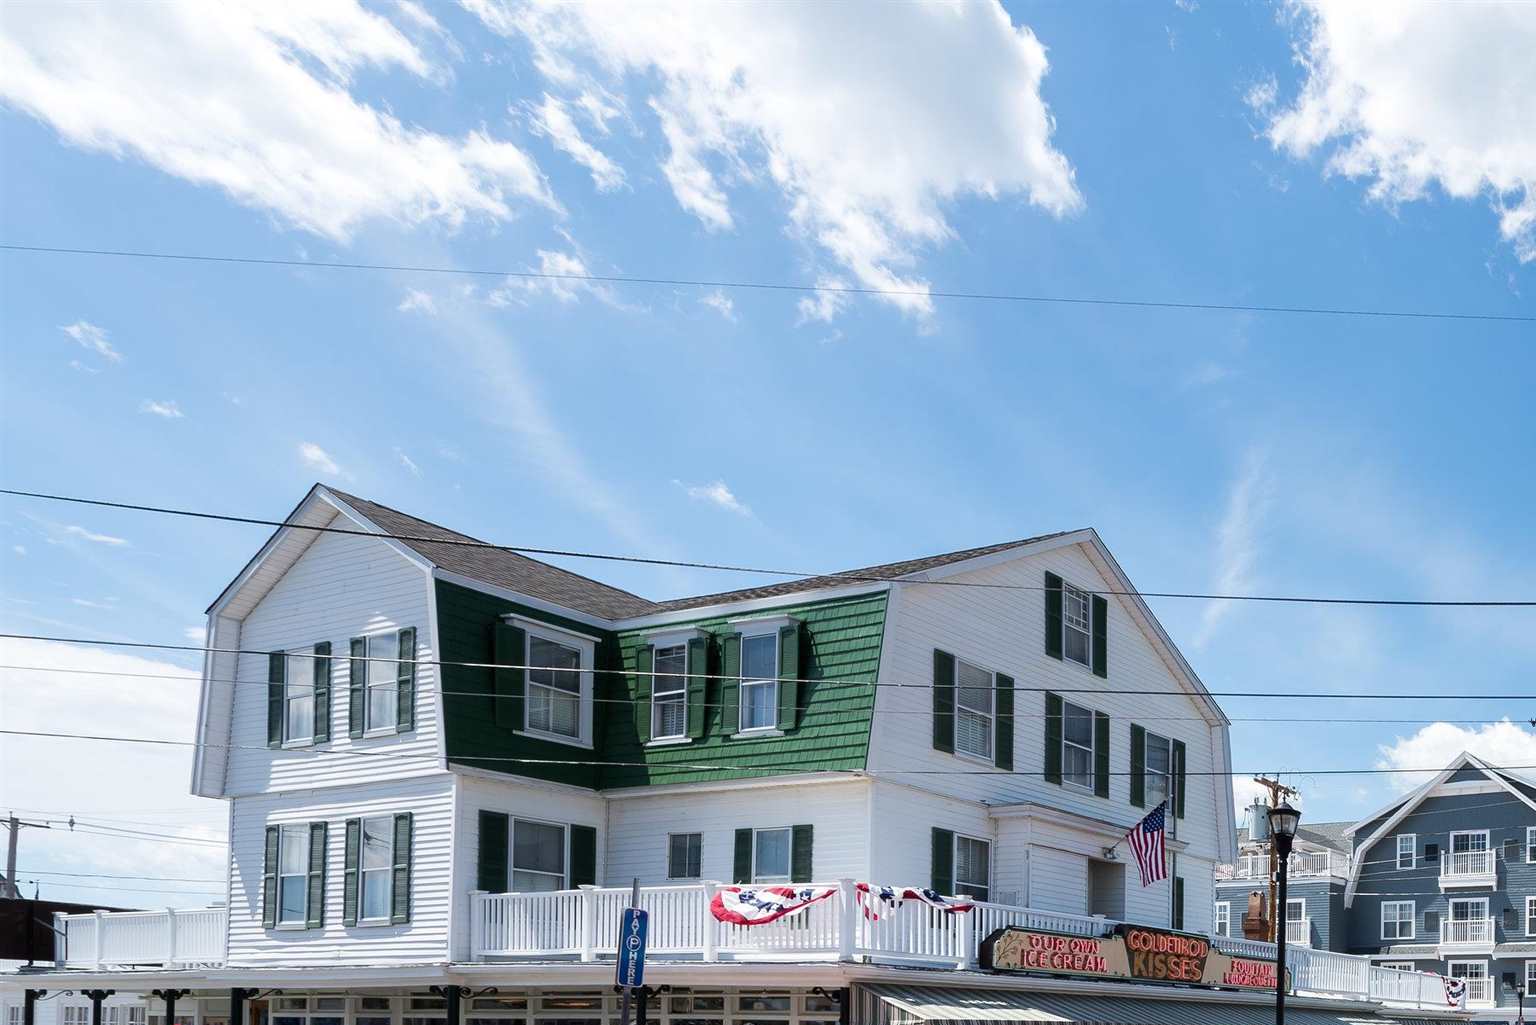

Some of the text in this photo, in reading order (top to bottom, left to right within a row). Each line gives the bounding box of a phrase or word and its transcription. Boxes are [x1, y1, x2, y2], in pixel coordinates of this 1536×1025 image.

[632, 910, 641, 935] PAY
[1030, 934, 1100, 954] OUR OWN
[1127, 930, 1208, 958] GOLDENROD
[627, 951, 638, 985] HERE
[1023, 950, 1107, 972] ICE CREAM
[1133, 952, 1202, 982] KISSES
[1231, 958, 1274, 976] FOUNTAIN
